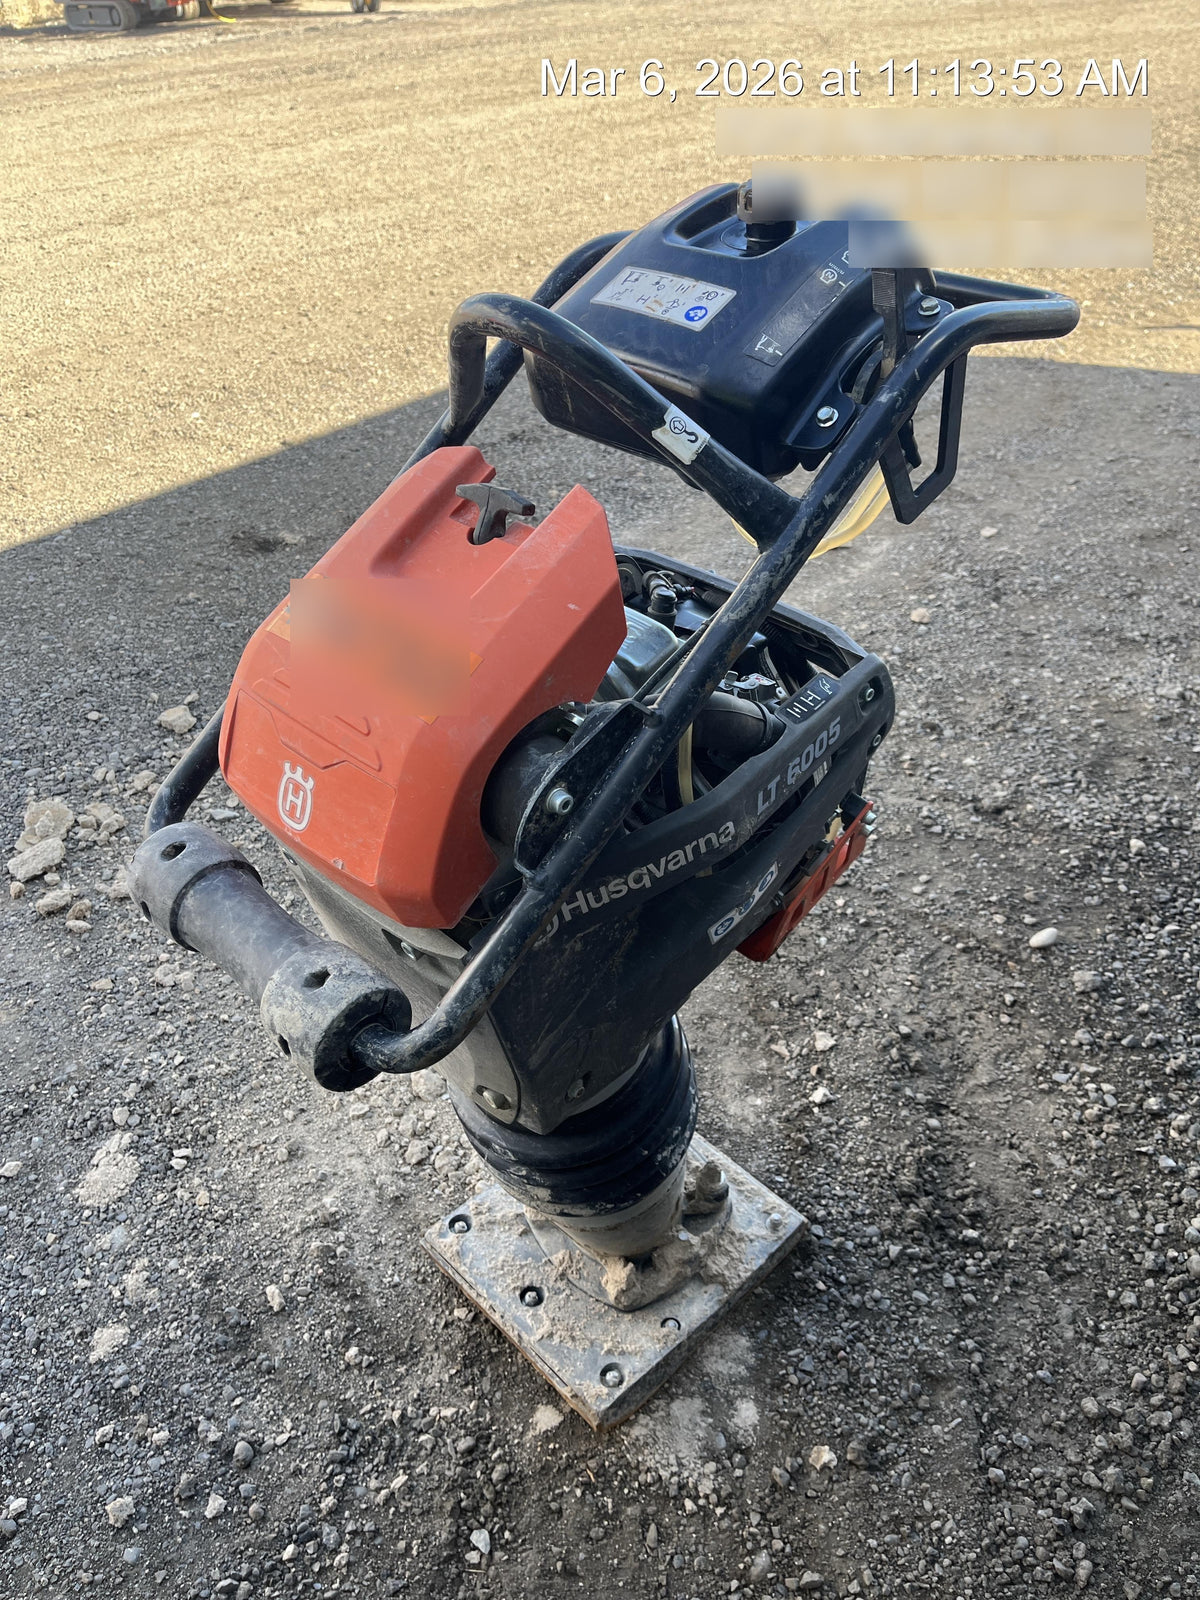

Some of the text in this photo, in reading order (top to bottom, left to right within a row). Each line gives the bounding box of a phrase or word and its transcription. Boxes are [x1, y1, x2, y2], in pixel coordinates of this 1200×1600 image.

[757, 716, 841, 816] LT 6005
[560, 821, 736, 923] Husqvarna
